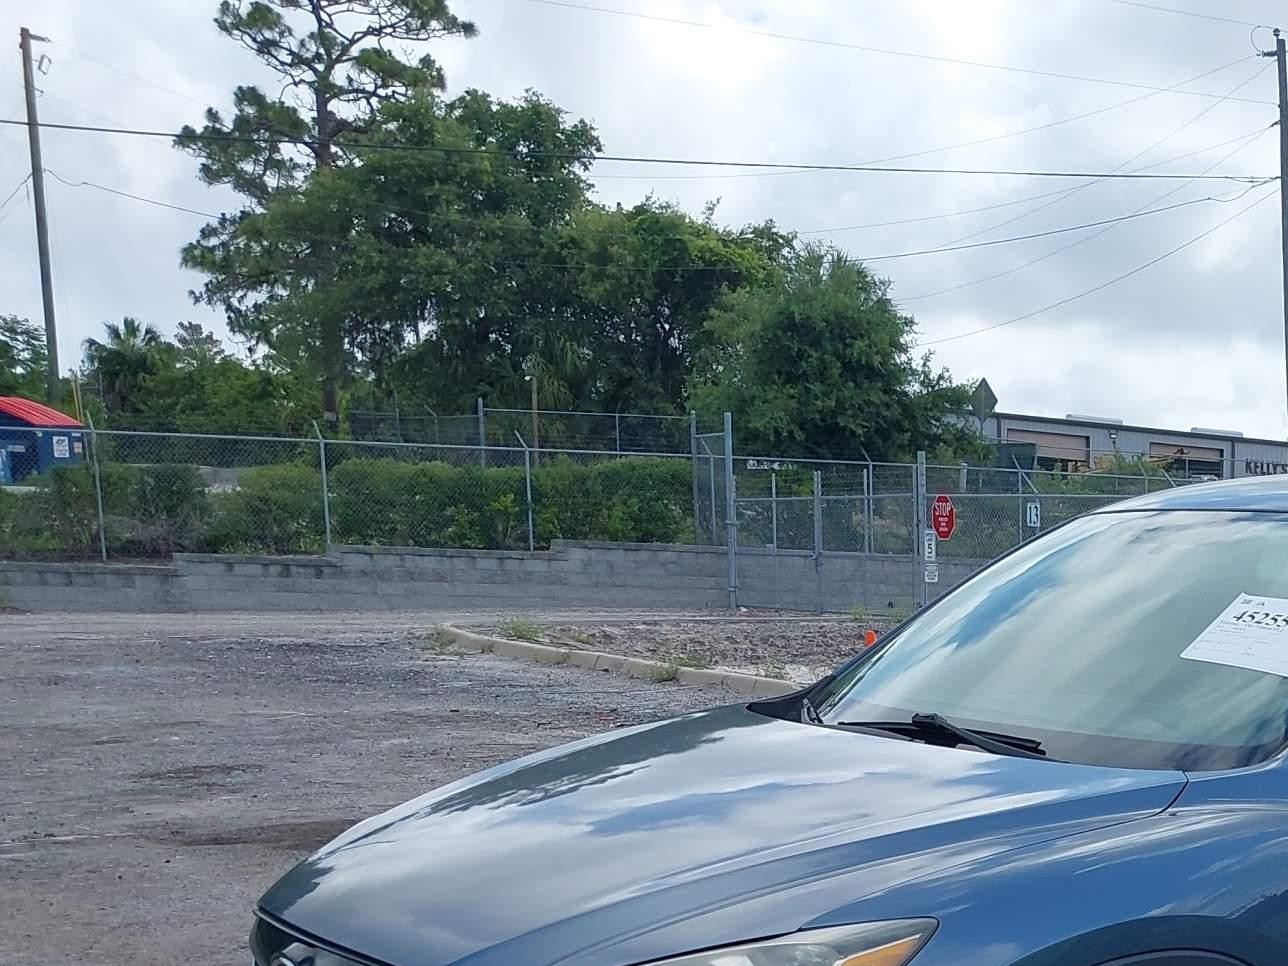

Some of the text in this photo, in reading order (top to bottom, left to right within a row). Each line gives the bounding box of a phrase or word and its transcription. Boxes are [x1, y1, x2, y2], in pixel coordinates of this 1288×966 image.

[1244, 459, 1288, 475] KELLY'S
[934, 502, 952, 516] STOP
[1028, 505, 1039, 525] 13
[927, 543, 933, 555] 5
